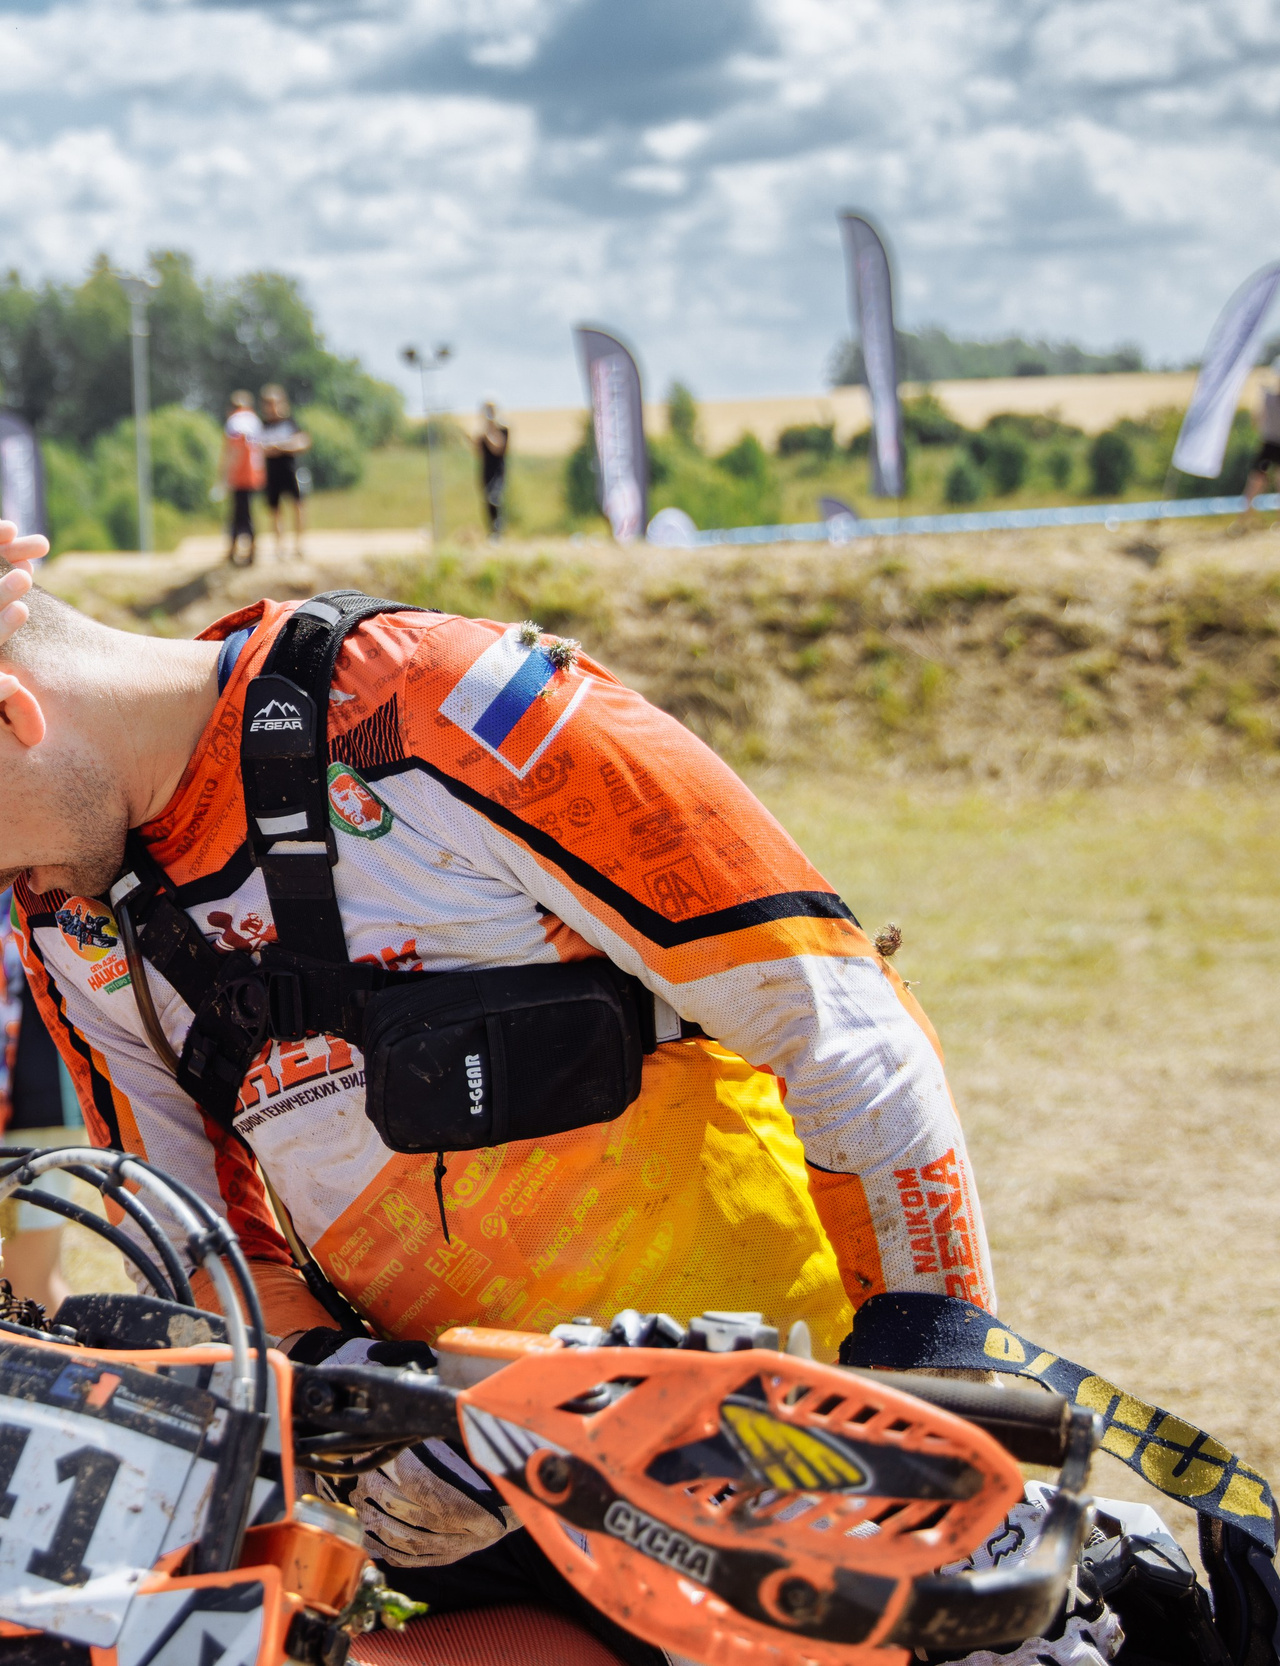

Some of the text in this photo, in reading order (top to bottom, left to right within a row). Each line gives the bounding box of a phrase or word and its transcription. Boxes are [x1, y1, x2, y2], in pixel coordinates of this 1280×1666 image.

[250, 721, 303, 732] E-GEAR
[87, 956, 130, 992] НАИКО
[102, 954, 118, 969] АЗС
[260, 1080, 340, 1120] ТЕХНИЧЕСКИХ
[465, 1053, 484, 1115] E-GEAR
[510, 1154, 560, 1216] СТРАНЫ
[892, 1167, 939, 1273] NAIKOM
[338, 1226, 368, 1258] колеса
[348, 1237, 377, 1269] даром
[424, 1233, 469, 1278] ЕАЗ
[603, 1500, 718, 1584] CYCRA
